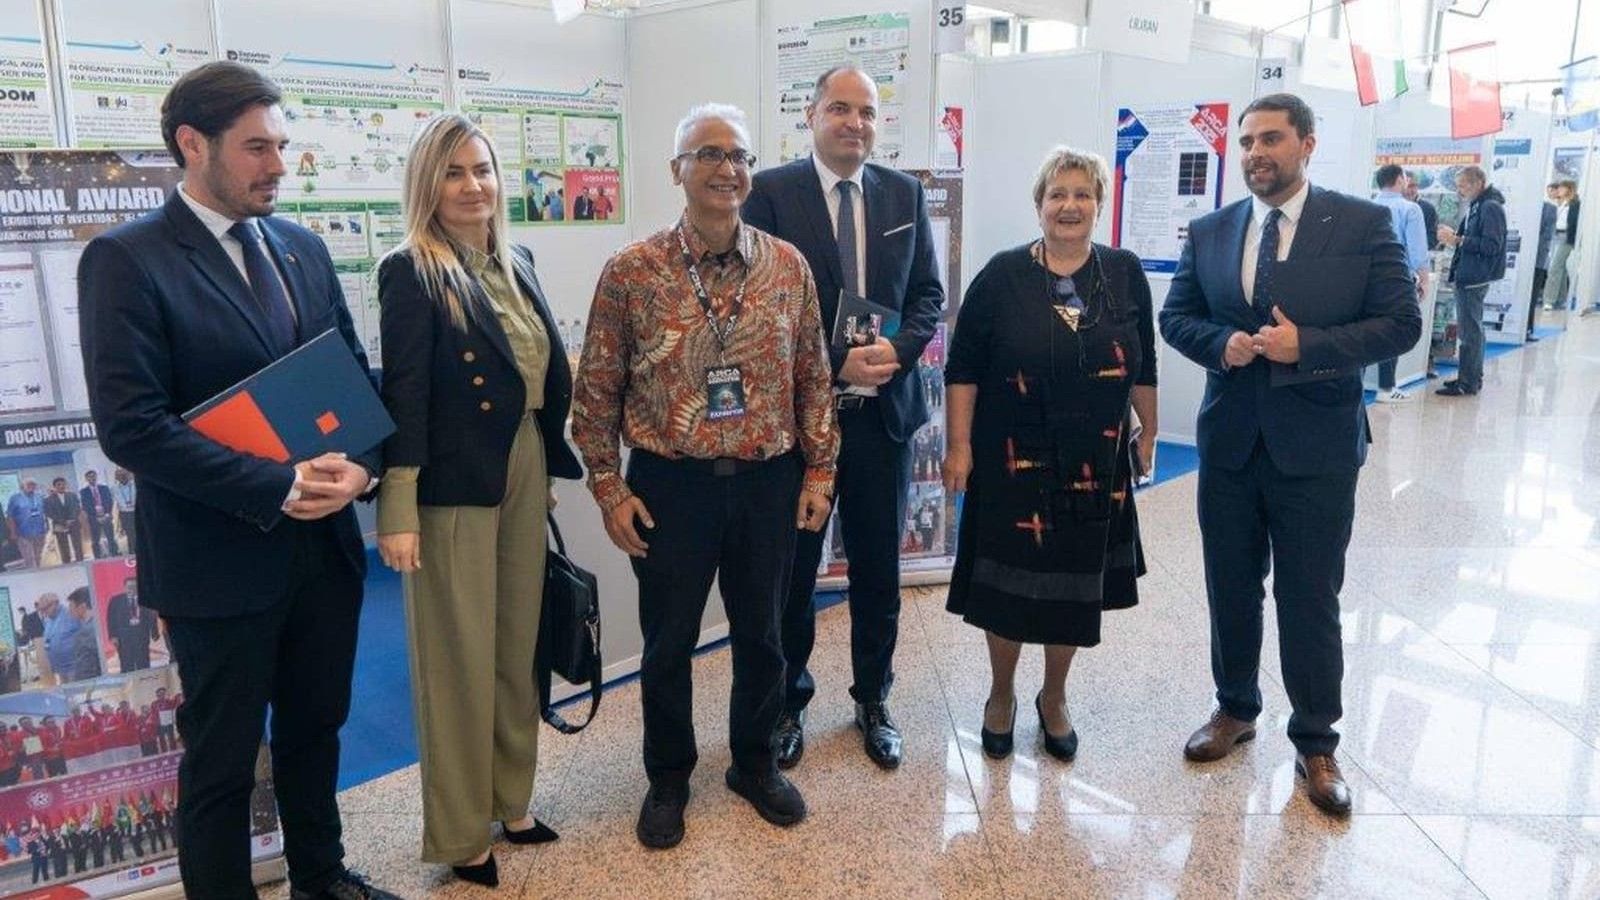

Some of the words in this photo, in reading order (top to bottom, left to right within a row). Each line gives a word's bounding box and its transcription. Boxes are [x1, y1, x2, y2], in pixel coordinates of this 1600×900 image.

[939, 8, 963, 27] 35
[1262, 67, 1282, 80] 34
[78, 187, 164, 211] AWARD
[54, 214, 65, 225] OF
[47, 229, 75, 239] CHINA
[707, 368, 741, 379] ARCA
